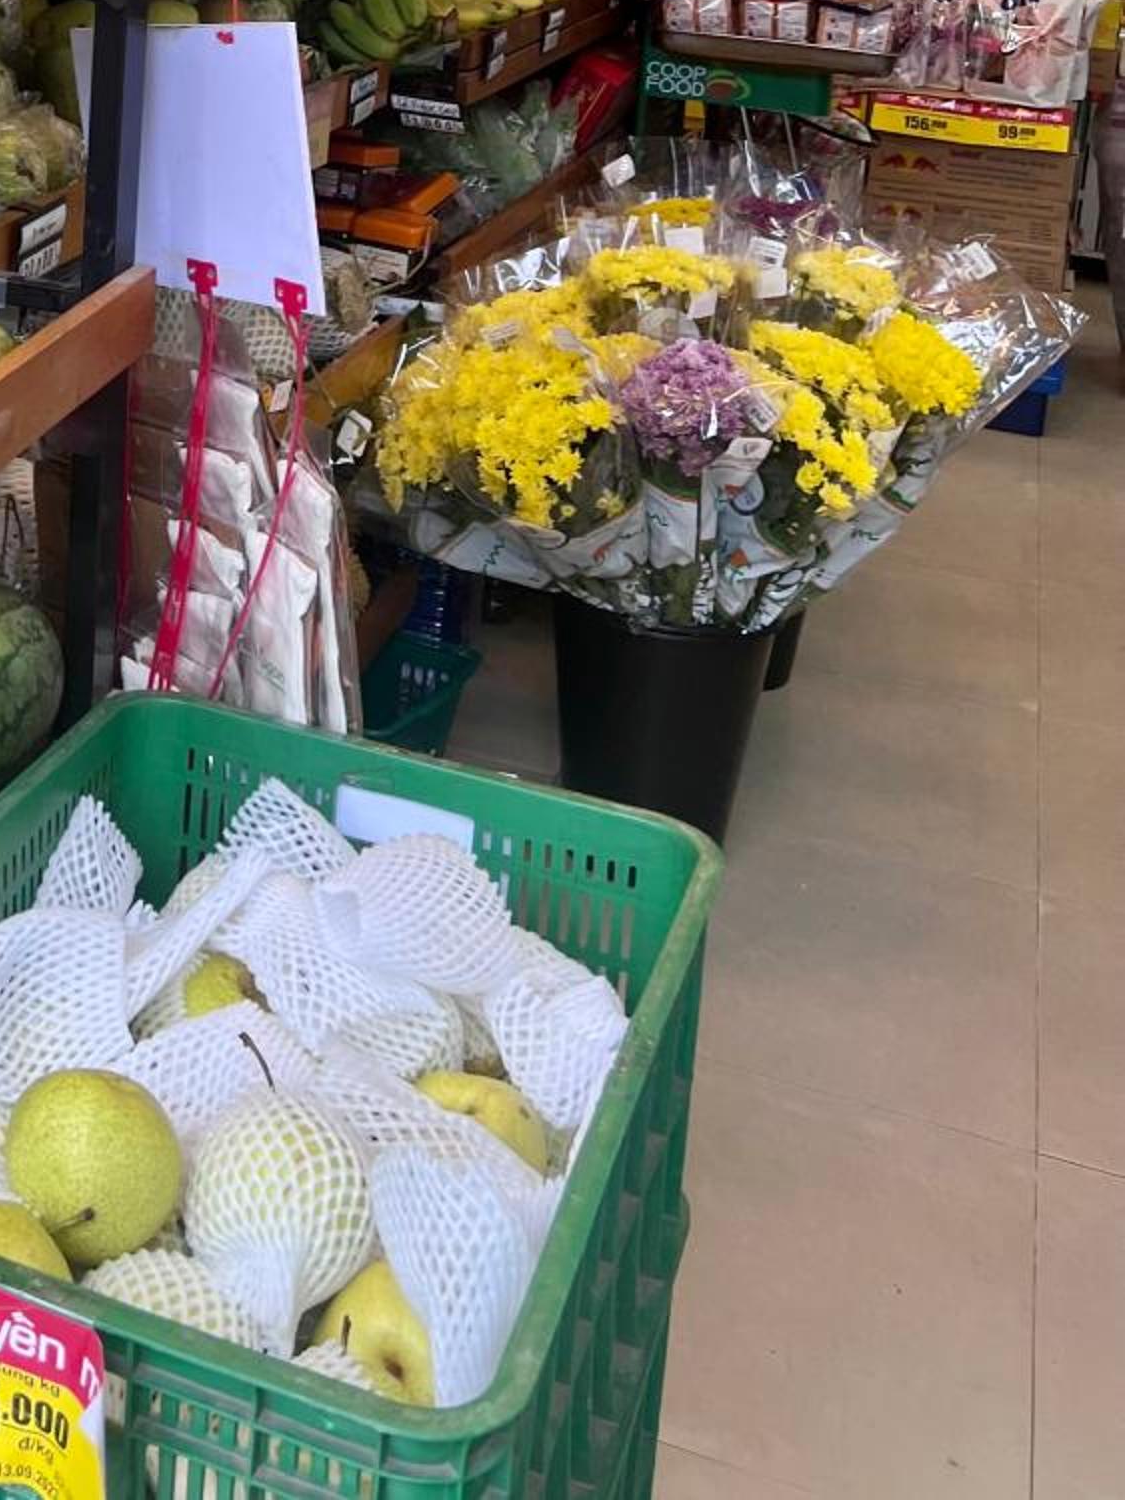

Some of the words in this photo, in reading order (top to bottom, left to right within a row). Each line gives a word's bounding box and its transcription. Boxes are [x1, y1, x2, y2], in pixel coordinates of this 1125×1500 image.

[646, 61, 707, 81] COOP
[645, 75, 706, 97] FOOD
[40, 1375, 60, 1398] kg
